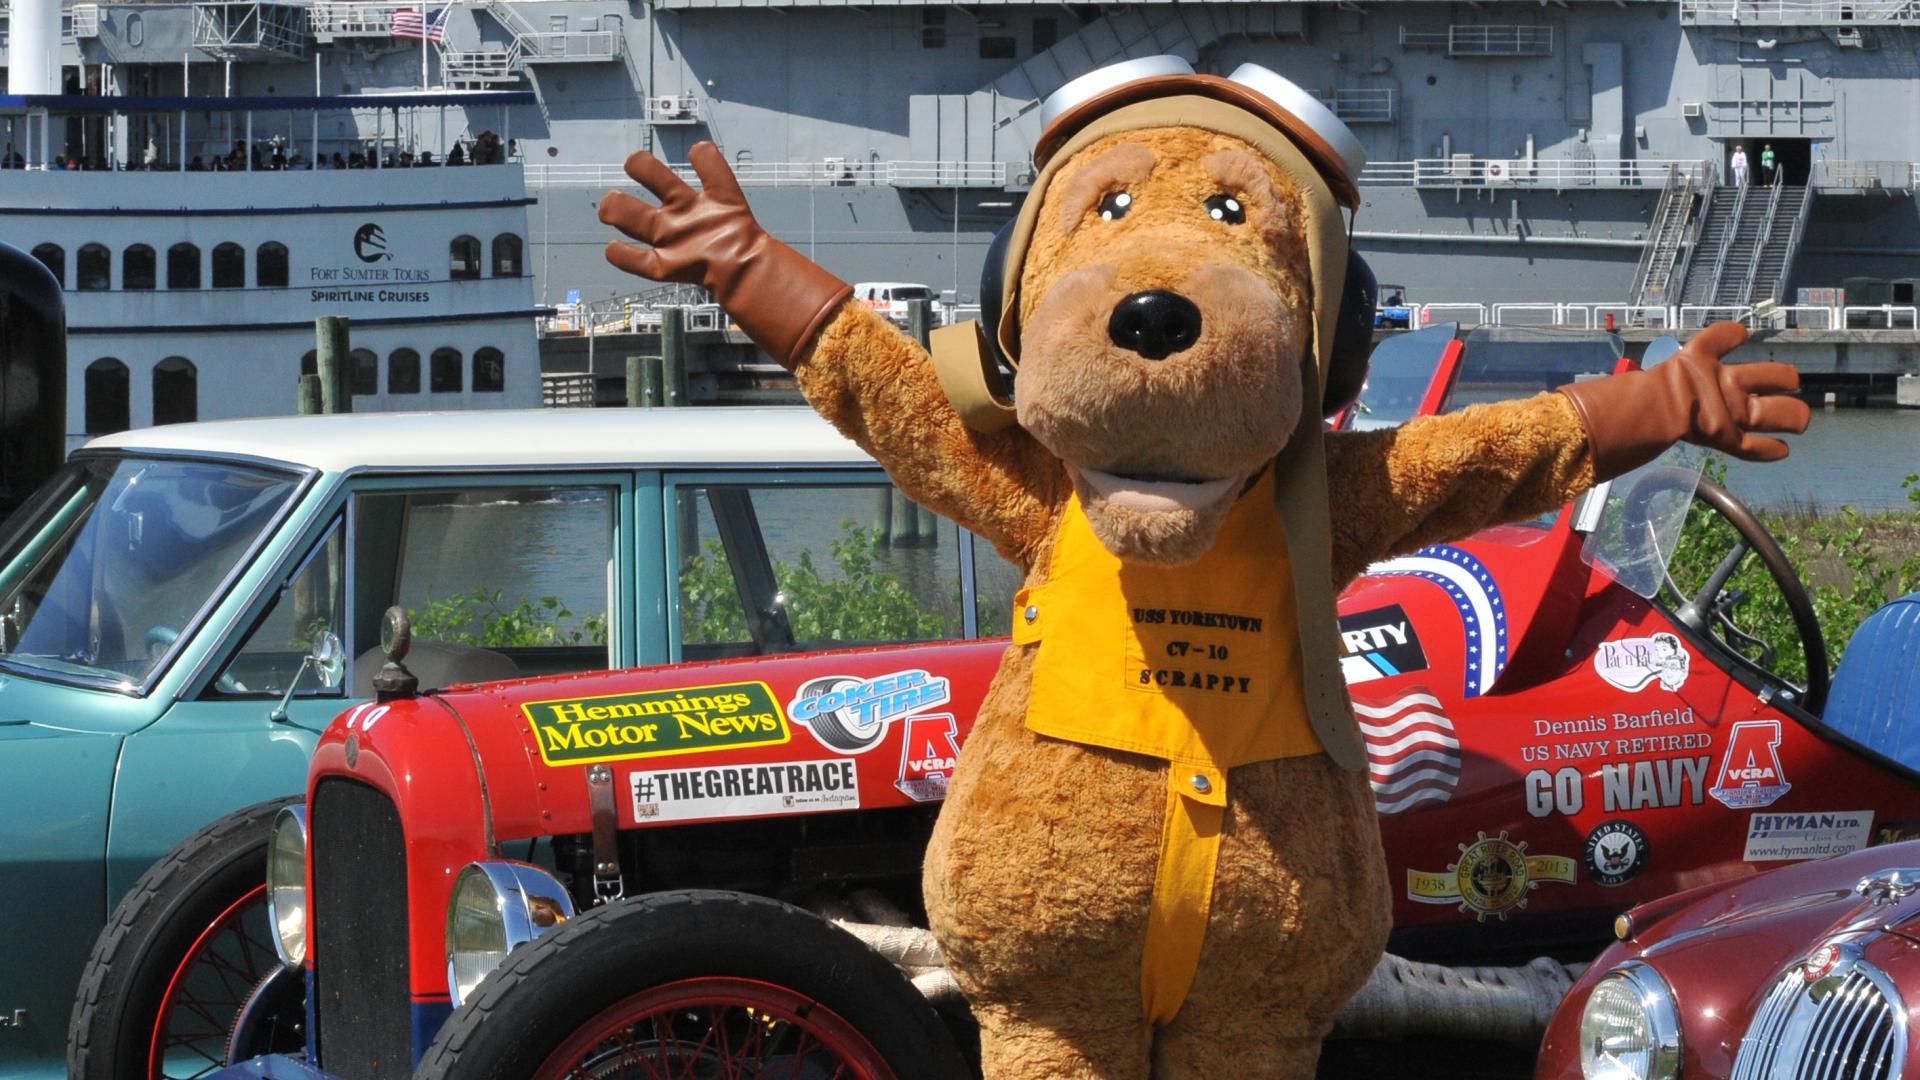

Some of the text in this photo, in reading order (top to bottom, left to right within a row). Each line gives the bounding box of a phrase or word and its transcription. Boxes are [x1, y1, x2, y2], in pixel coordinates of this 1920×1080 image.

[311, 267, 430, 280] FORT SUMTER TOURS
[378, 290, 429, 302] CRUISES
[1133, 608, 1262, 632] USS YORKTOWN
[1341, 621, 1407, 653] RTY
[1604, 645, 1622, 669] Pat
[1634, 645, 1652, 667] Pat
[1140, 668, 1250, 693] SCRAPPY
[548, 693, 751, 723] Hemmings
[792, 671, 926, 721] COKER
[850, 680, 947, 728] TIRE
[542, 711, 777, 752] Motor News
[1534, 707, 1695, 736] Dennis Barfield
[1521, 733, 1712, 762] US NAVY RETIRED
[909, 757, 957, 772] VCRA
[1728, 767, 1775, 780] VCRA
[634, 762, 855, 803] #THEGREATRACE
[1525, 755, 1712, 818] GO NAVY
[1753, 814, 1836, 831] HYMAN
[1585, 823, 1645, 862] UNITED STATES
[1749, 843, 1856, 858] www.hymanltd.com
[1461, 850, 1480, 878] GREAT
[1509, 851, 1525, 877] ROAD
[1536, 860, 1569, 874] 2013
[1415, 876, 1446, 891] 1938
